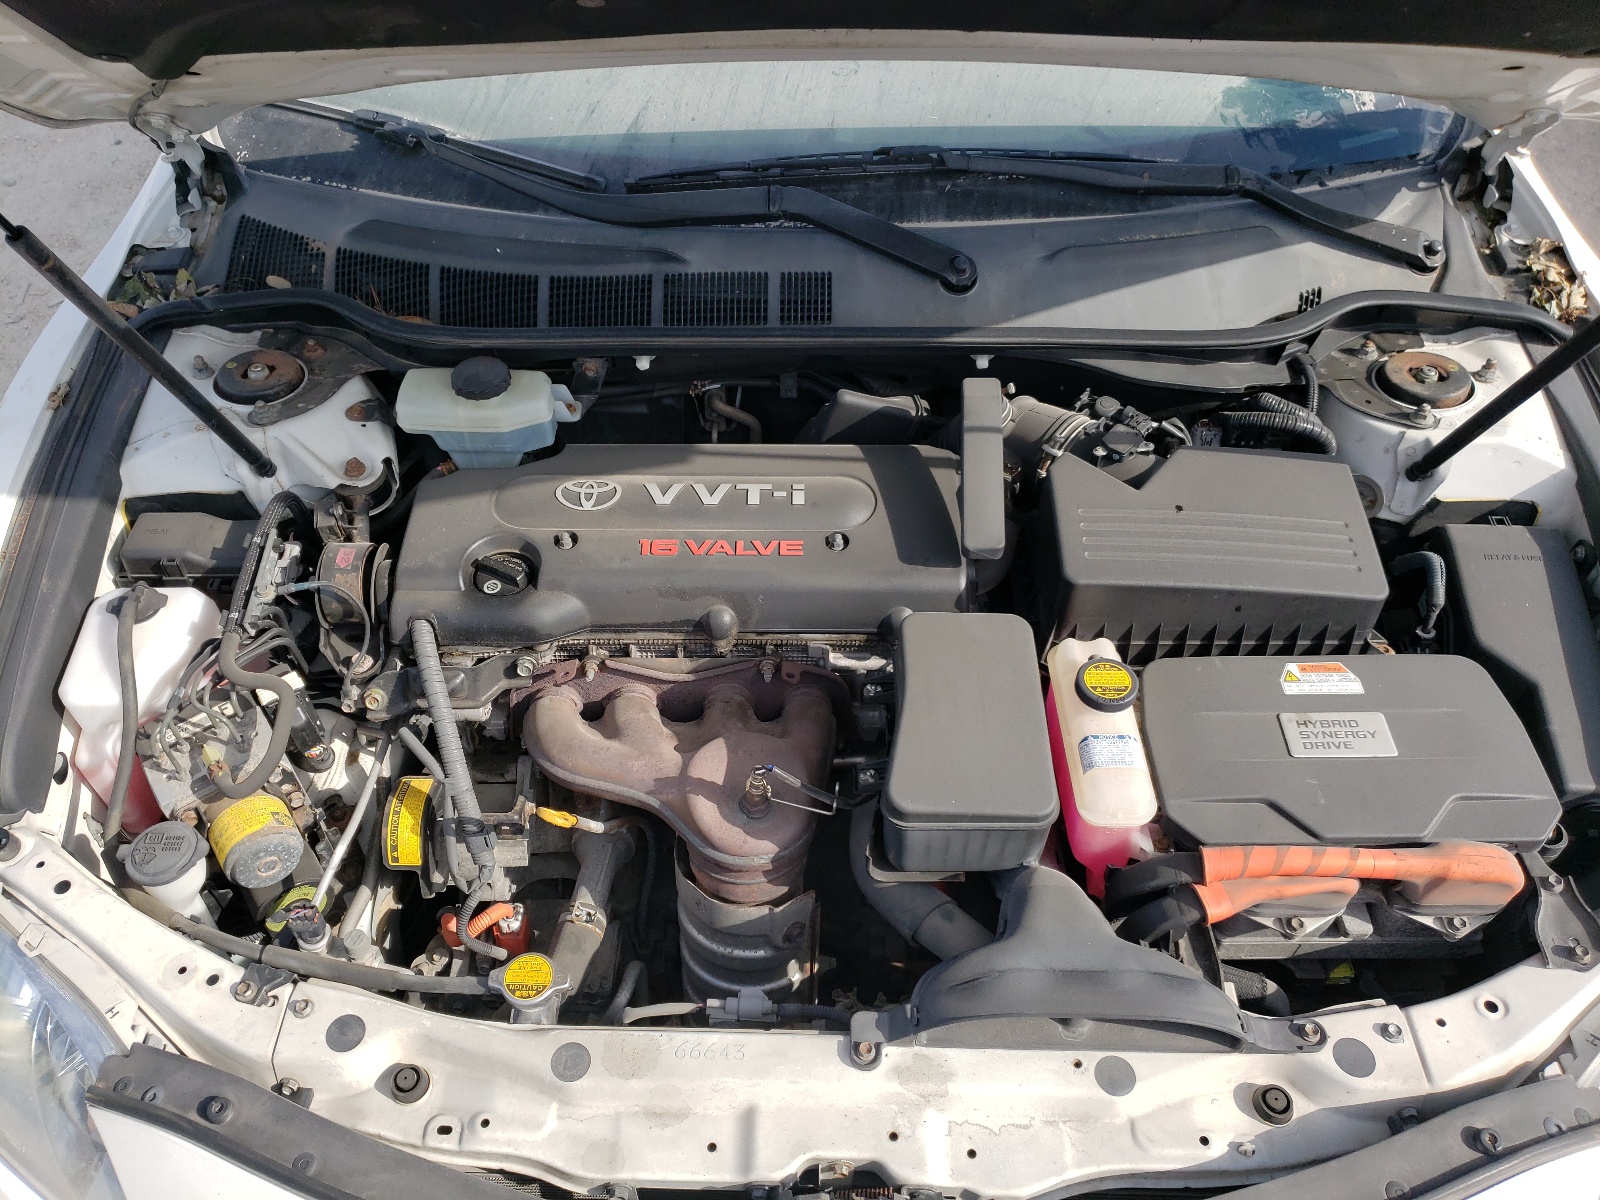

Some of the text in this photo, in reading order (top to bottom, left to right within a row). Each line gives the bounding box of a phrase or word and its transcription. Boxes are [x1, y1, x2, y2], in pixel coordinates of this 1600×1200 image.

[643, 483, 805, 506] VVT-i
[638, 538, 804, 557] 16 VALVE
[1295, 719, 1360, 729] HYBRID
[1299, 730, 1377, 739] SYNERGY
[1302, 740, 1355, 750] DRIVE
[390, 781, 411, 846] CAUTION ATTENTION
[674, 1040, 745, 1061] 66643
